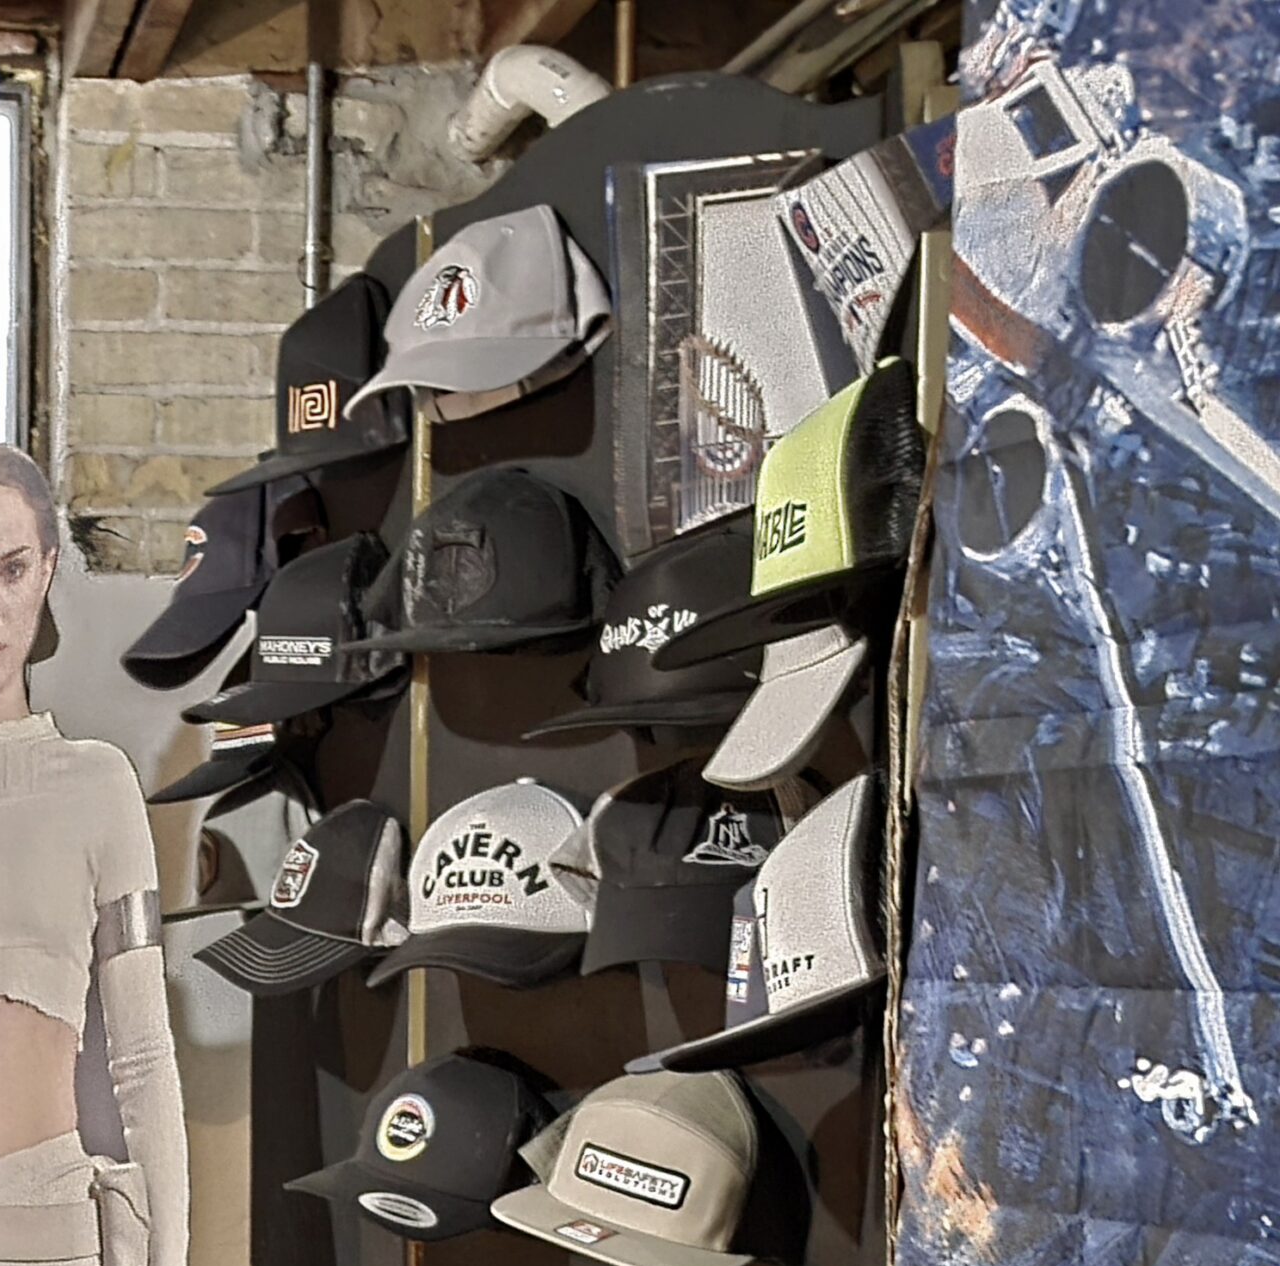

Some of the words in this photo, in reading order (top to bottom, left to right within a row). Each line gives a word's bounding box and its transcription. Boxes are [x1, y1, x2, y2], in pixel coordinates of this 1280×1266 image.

[422, 832, 550, 899] CAVERN
[445, 870, 504, 888] CLUB
[436, 893, 512, 906] LIVERPOOL
